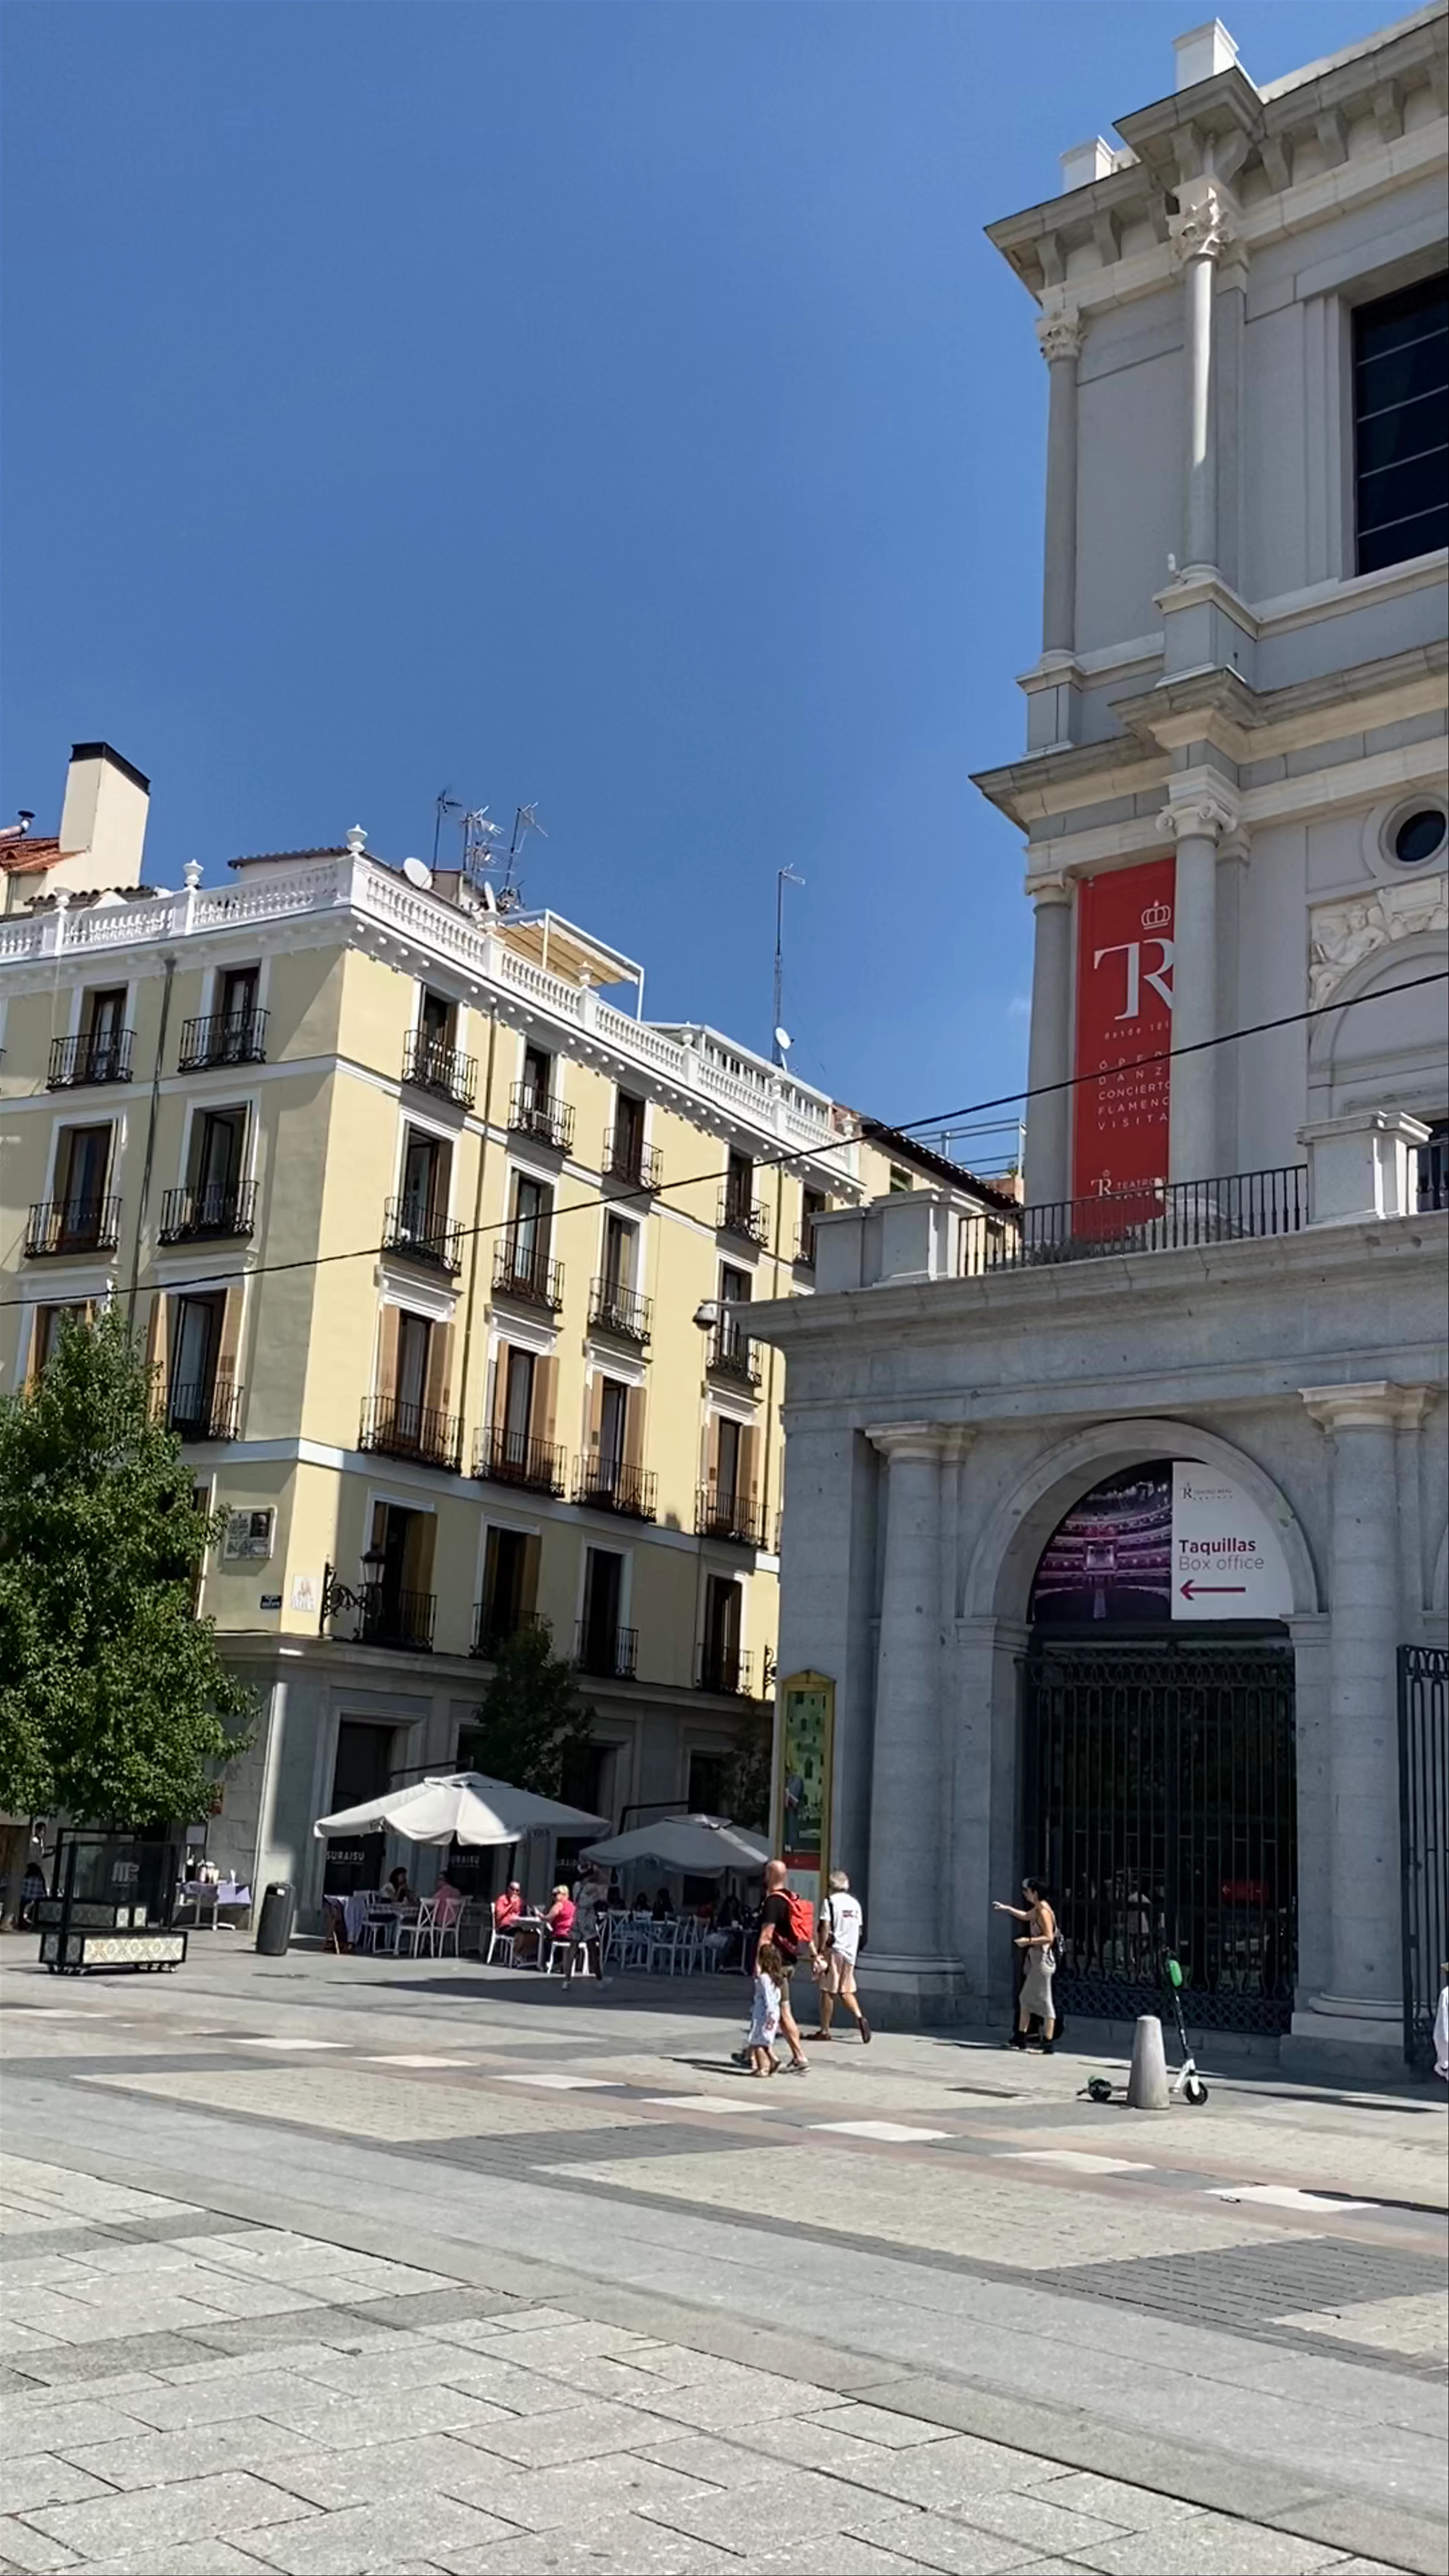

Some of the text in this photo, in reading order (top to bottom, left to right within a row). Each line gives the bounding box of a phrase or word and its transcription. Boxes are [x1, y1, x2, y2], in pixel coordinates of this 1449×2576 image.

[1178, 1537, 1256, 1556] Taquillas
[1179, 1554, 1264, 1571] Box office
